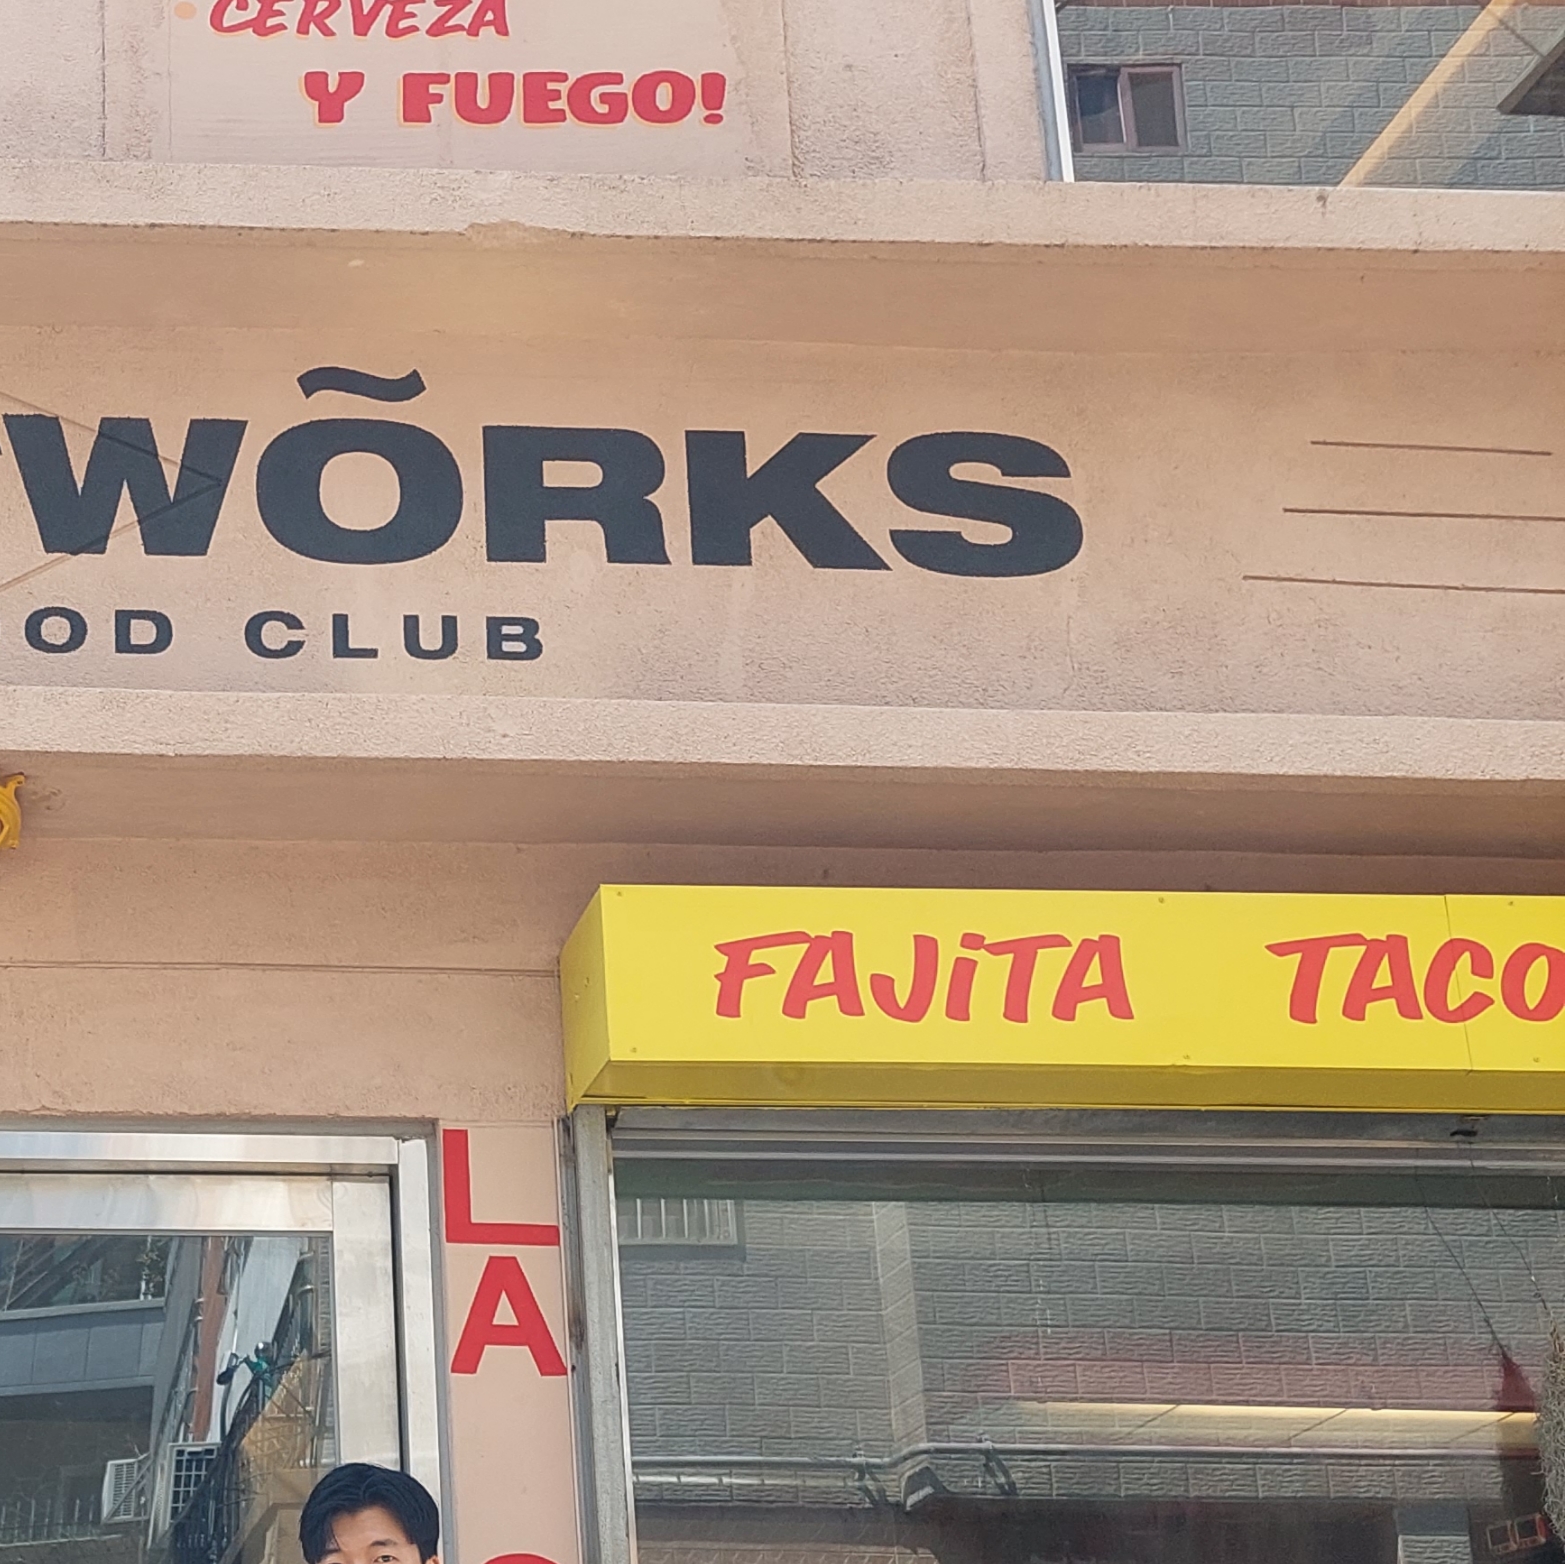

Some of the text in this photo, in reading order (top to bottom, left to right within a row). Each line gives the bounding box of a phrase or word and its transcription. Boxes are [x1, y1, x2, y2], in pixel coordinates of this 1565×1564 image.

[209, 0, 510, 38] CERVEZA
[302, 69, 728, 127] Y FUEGO!
[242, 610, 545, 661] CLUB
